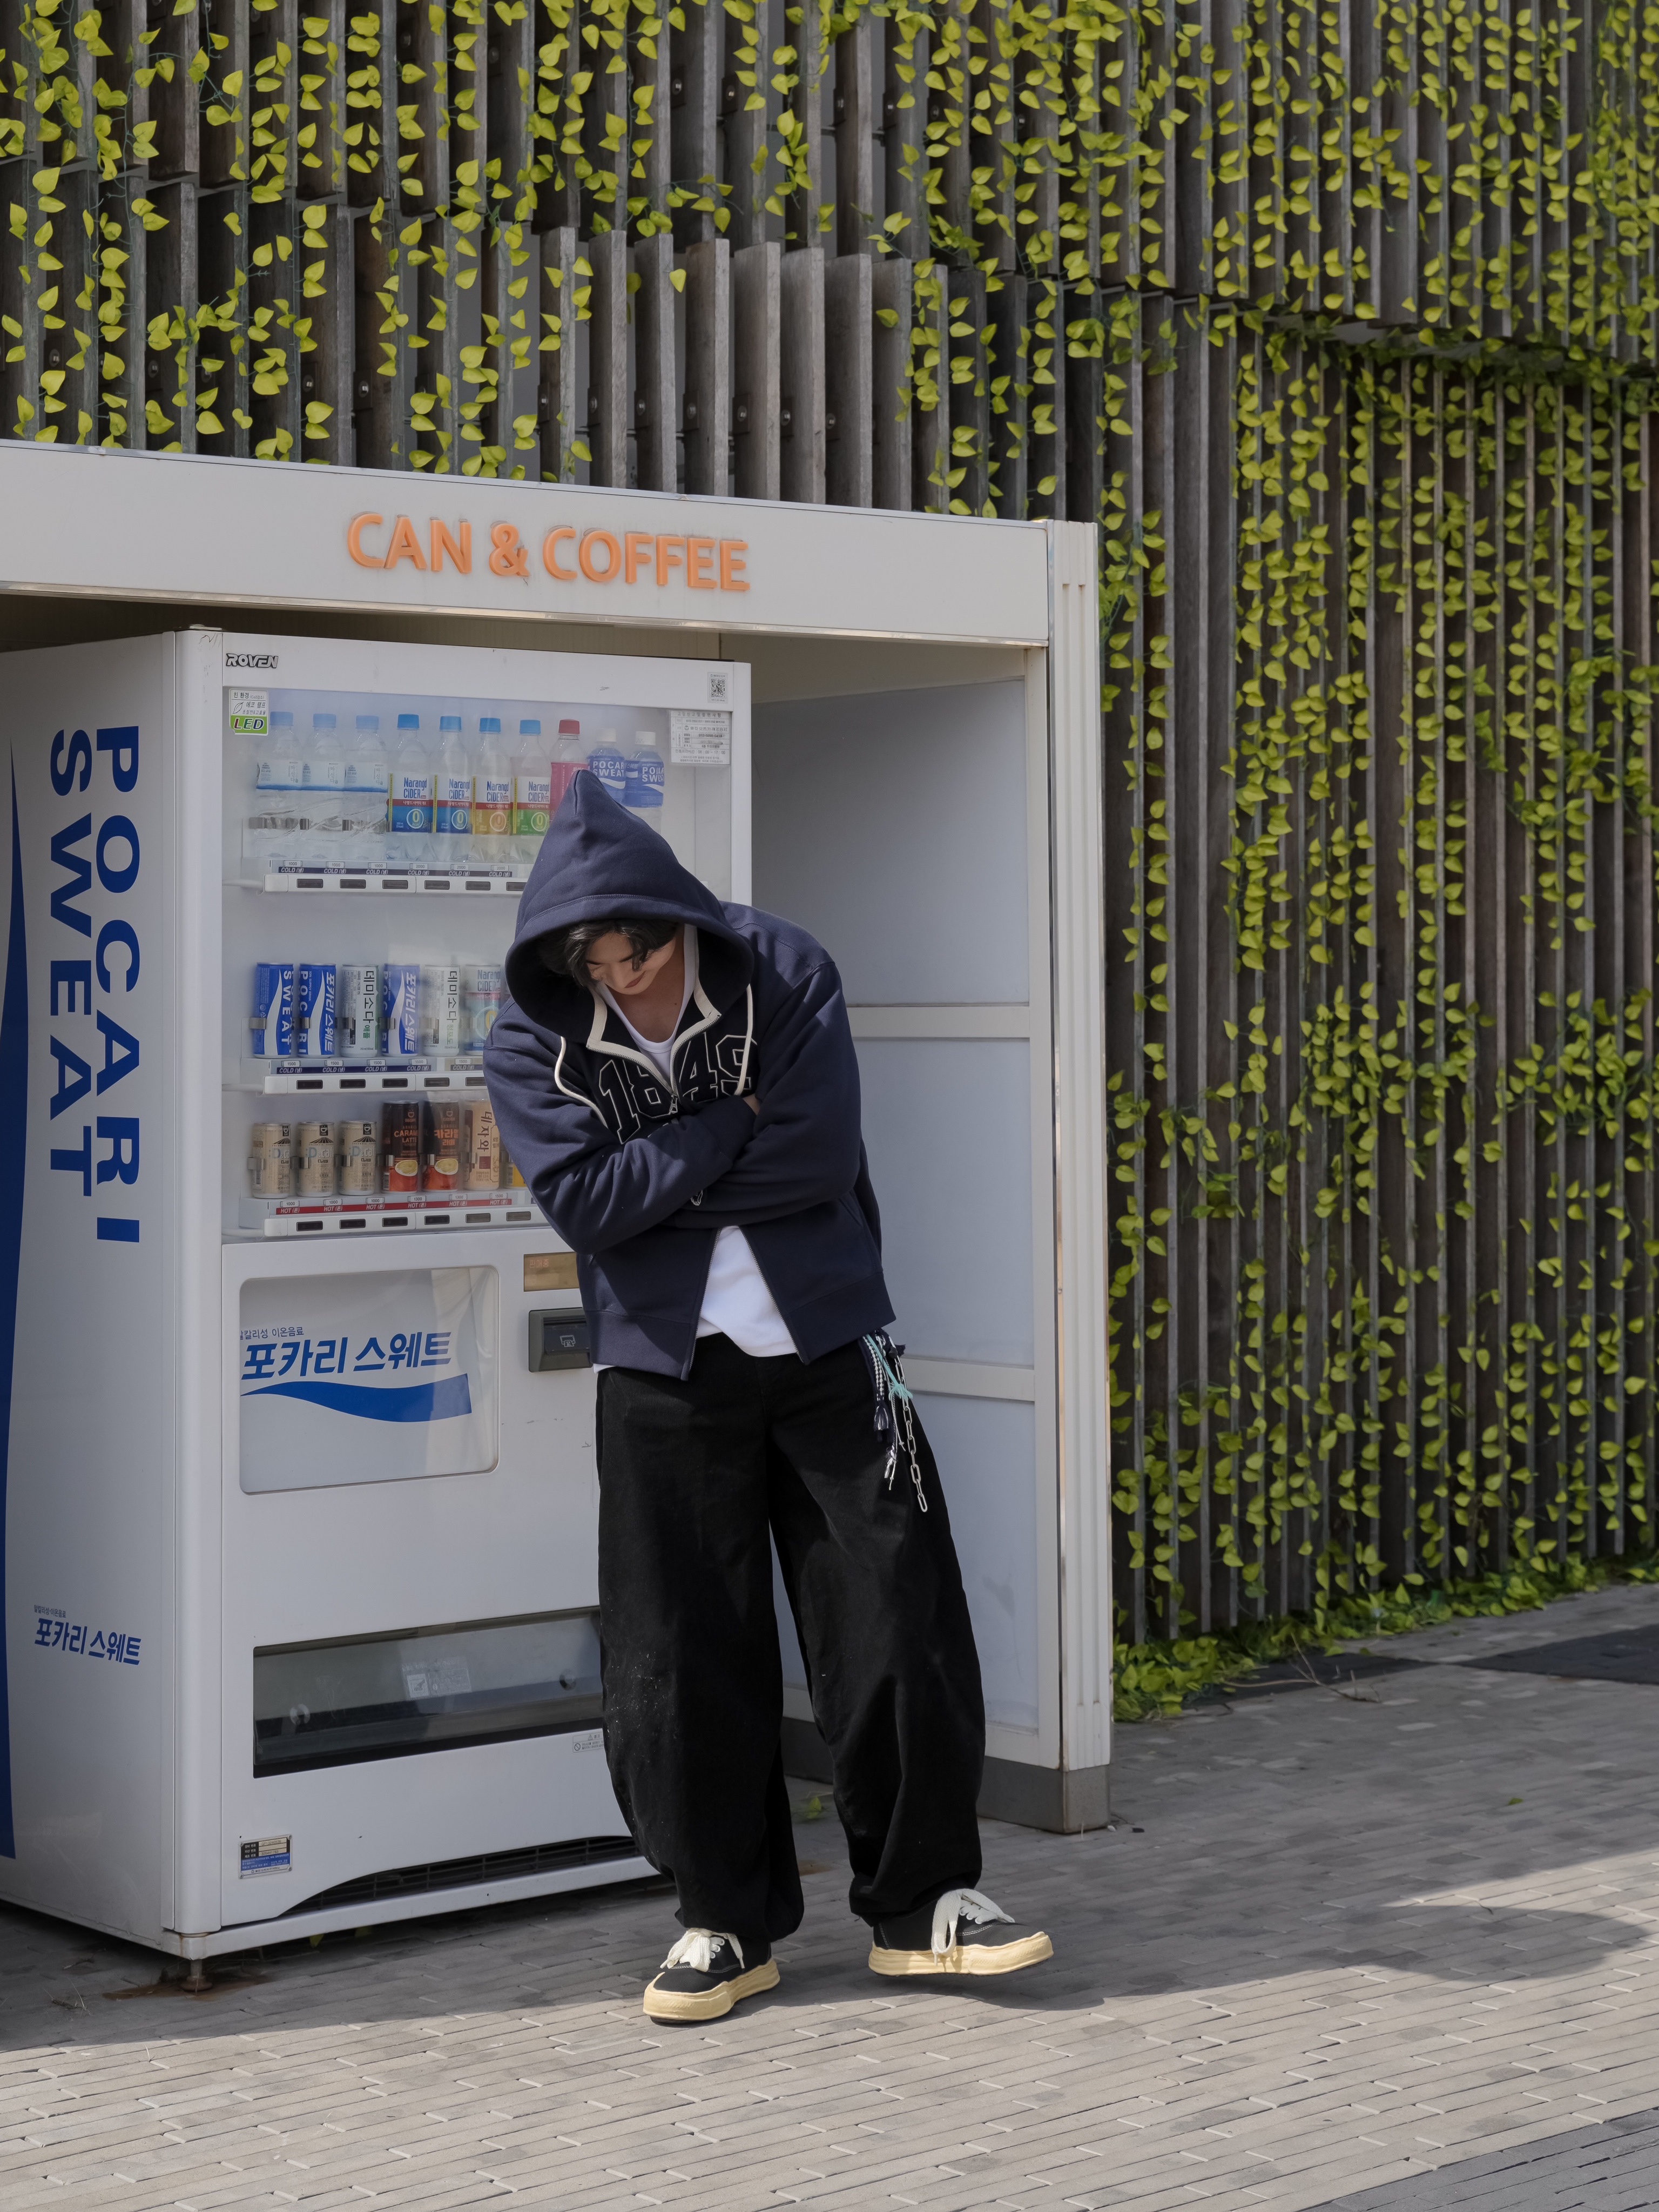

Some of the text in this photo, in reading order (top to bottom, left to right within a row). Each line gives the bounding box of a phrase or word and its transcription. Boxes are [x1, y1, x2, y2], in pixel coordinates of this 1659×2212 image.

[347, 513, 751, 590] CAN & COFFEE
[226, 653, 279, 668] ROVEN
[234, 718, 264, 730] LED
[50, 729, 92, 1197] SWEAT
[96, 726, 140, 1243] POCARI
[281, 970, 292, 1045] SWEAT
[299, 971, 308, 1053] POCRI
[325, 971, 335, 1053] 포카리 스웨트
[363, 971, 375, 1024] 데미소다
[405, 972, 416, 1052] 포카리 스웨트
[447, 971, 458, 1023] 데미소다
[363, 1025, 370, 1039] 애플
[477, 1111, 493, 1152] 데자와
[241, 1332, 452, 1380] 포카리 스웨트
[272, 1327, 304, 1337] 이온음료
[34, 1618, 141, 1665] 포카리 스웨트
